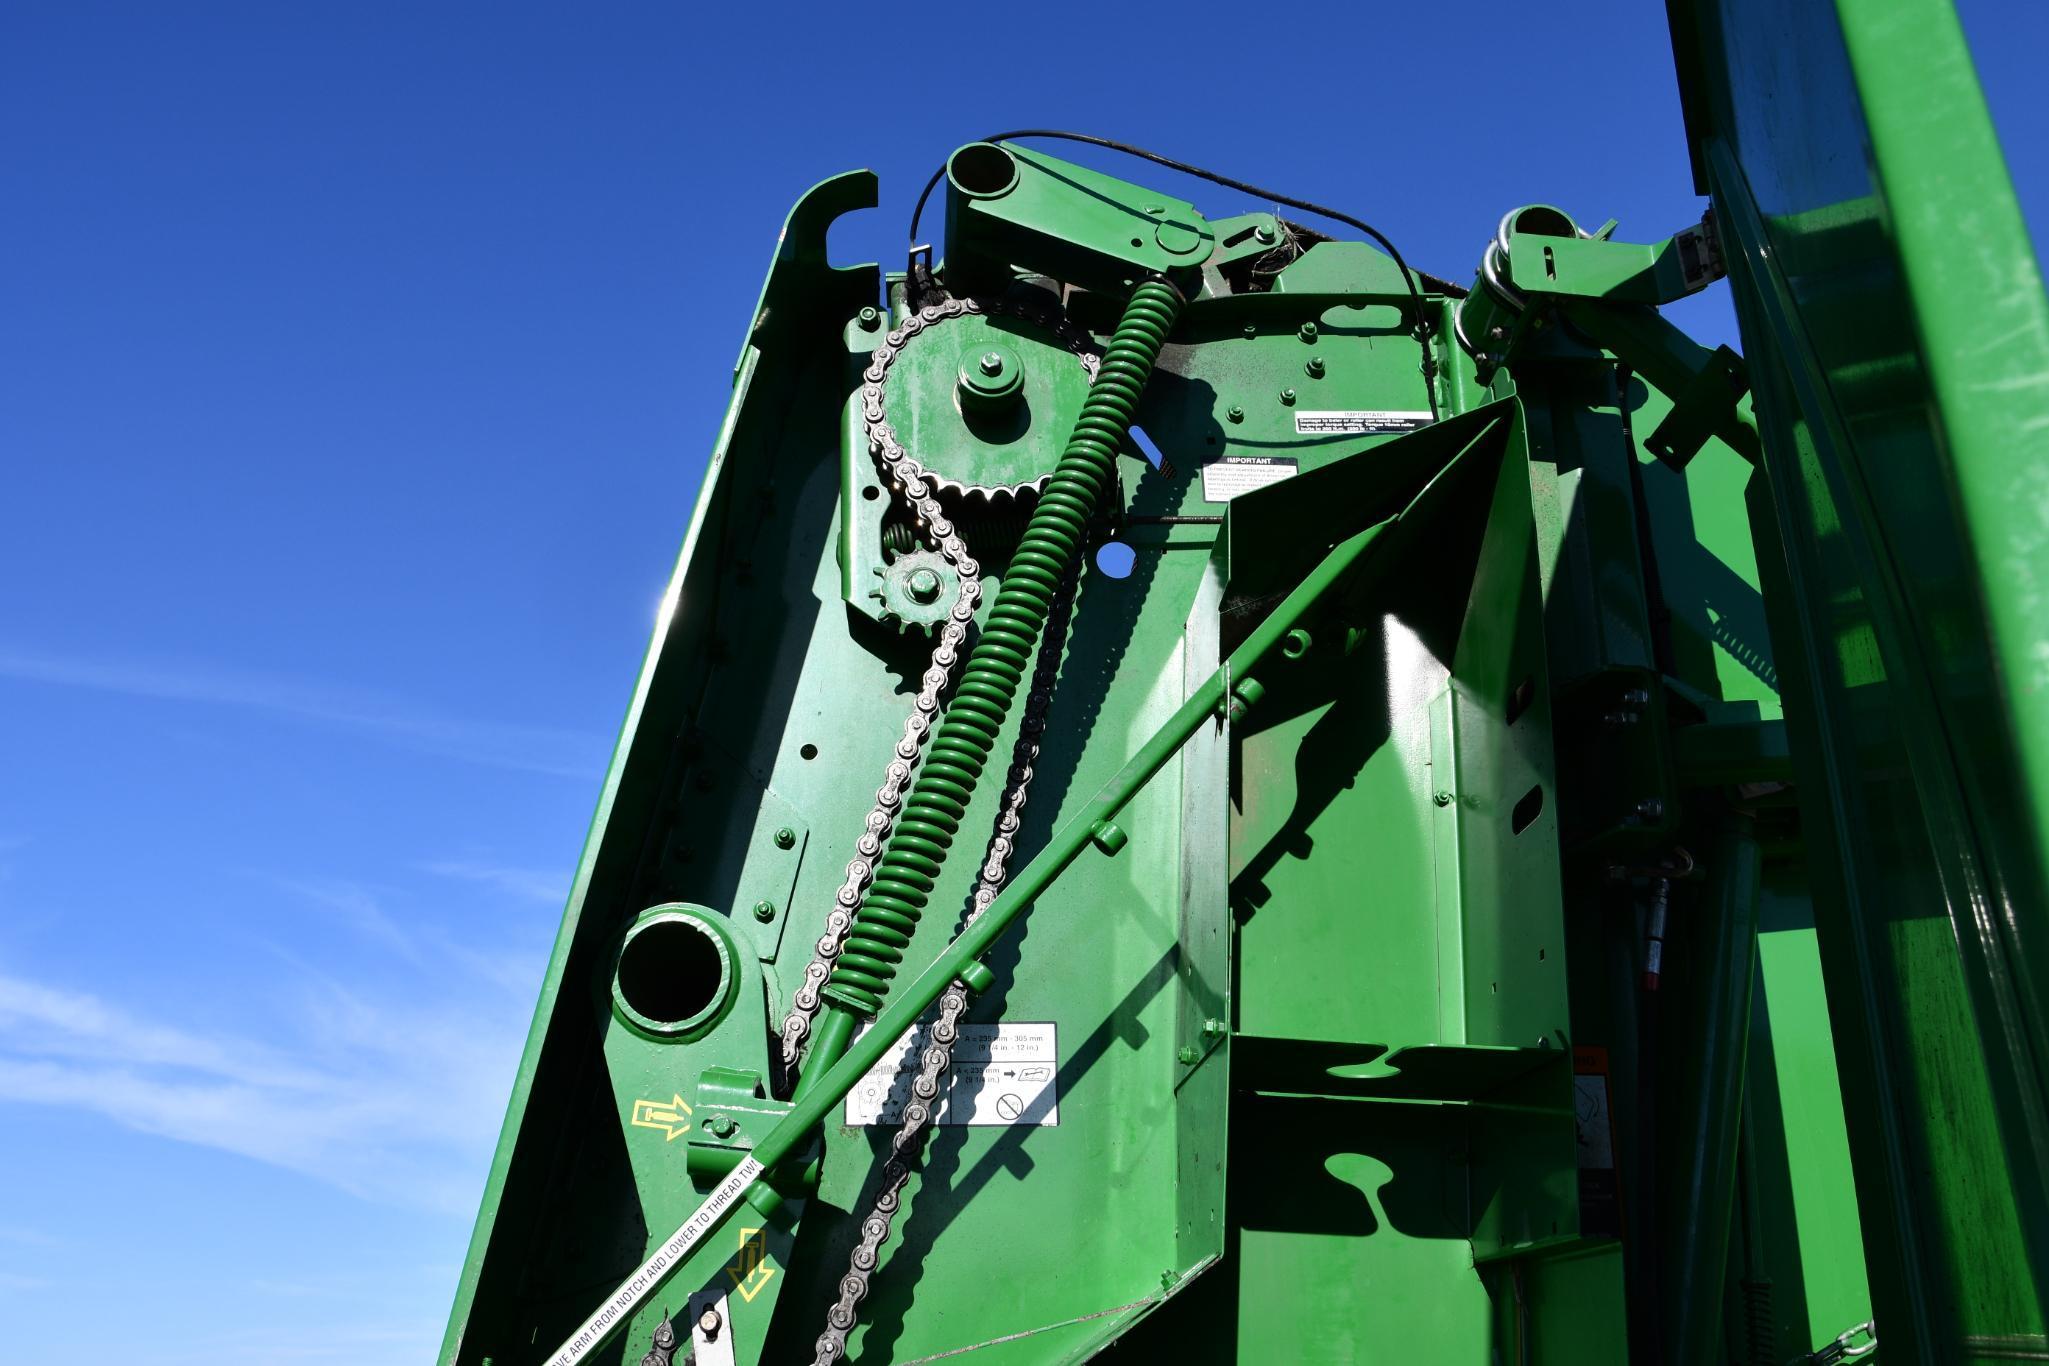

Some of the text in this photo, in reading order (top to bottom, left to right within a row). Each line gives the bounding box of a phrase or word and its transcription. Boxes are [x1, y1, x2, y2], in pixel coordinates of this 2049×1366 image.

[570, 1332, 593, 1357] ARM
[590, 1305, 619, 1335] FROM
[617, 1274, 648, 1309] NOTCH
[647, 1256, 667, 1279] AND
[666, 1225, 698, 1260] LOWER
[694, 1212, 710, 1227] TO
[707, 1178, 742, 1215] THREAD
